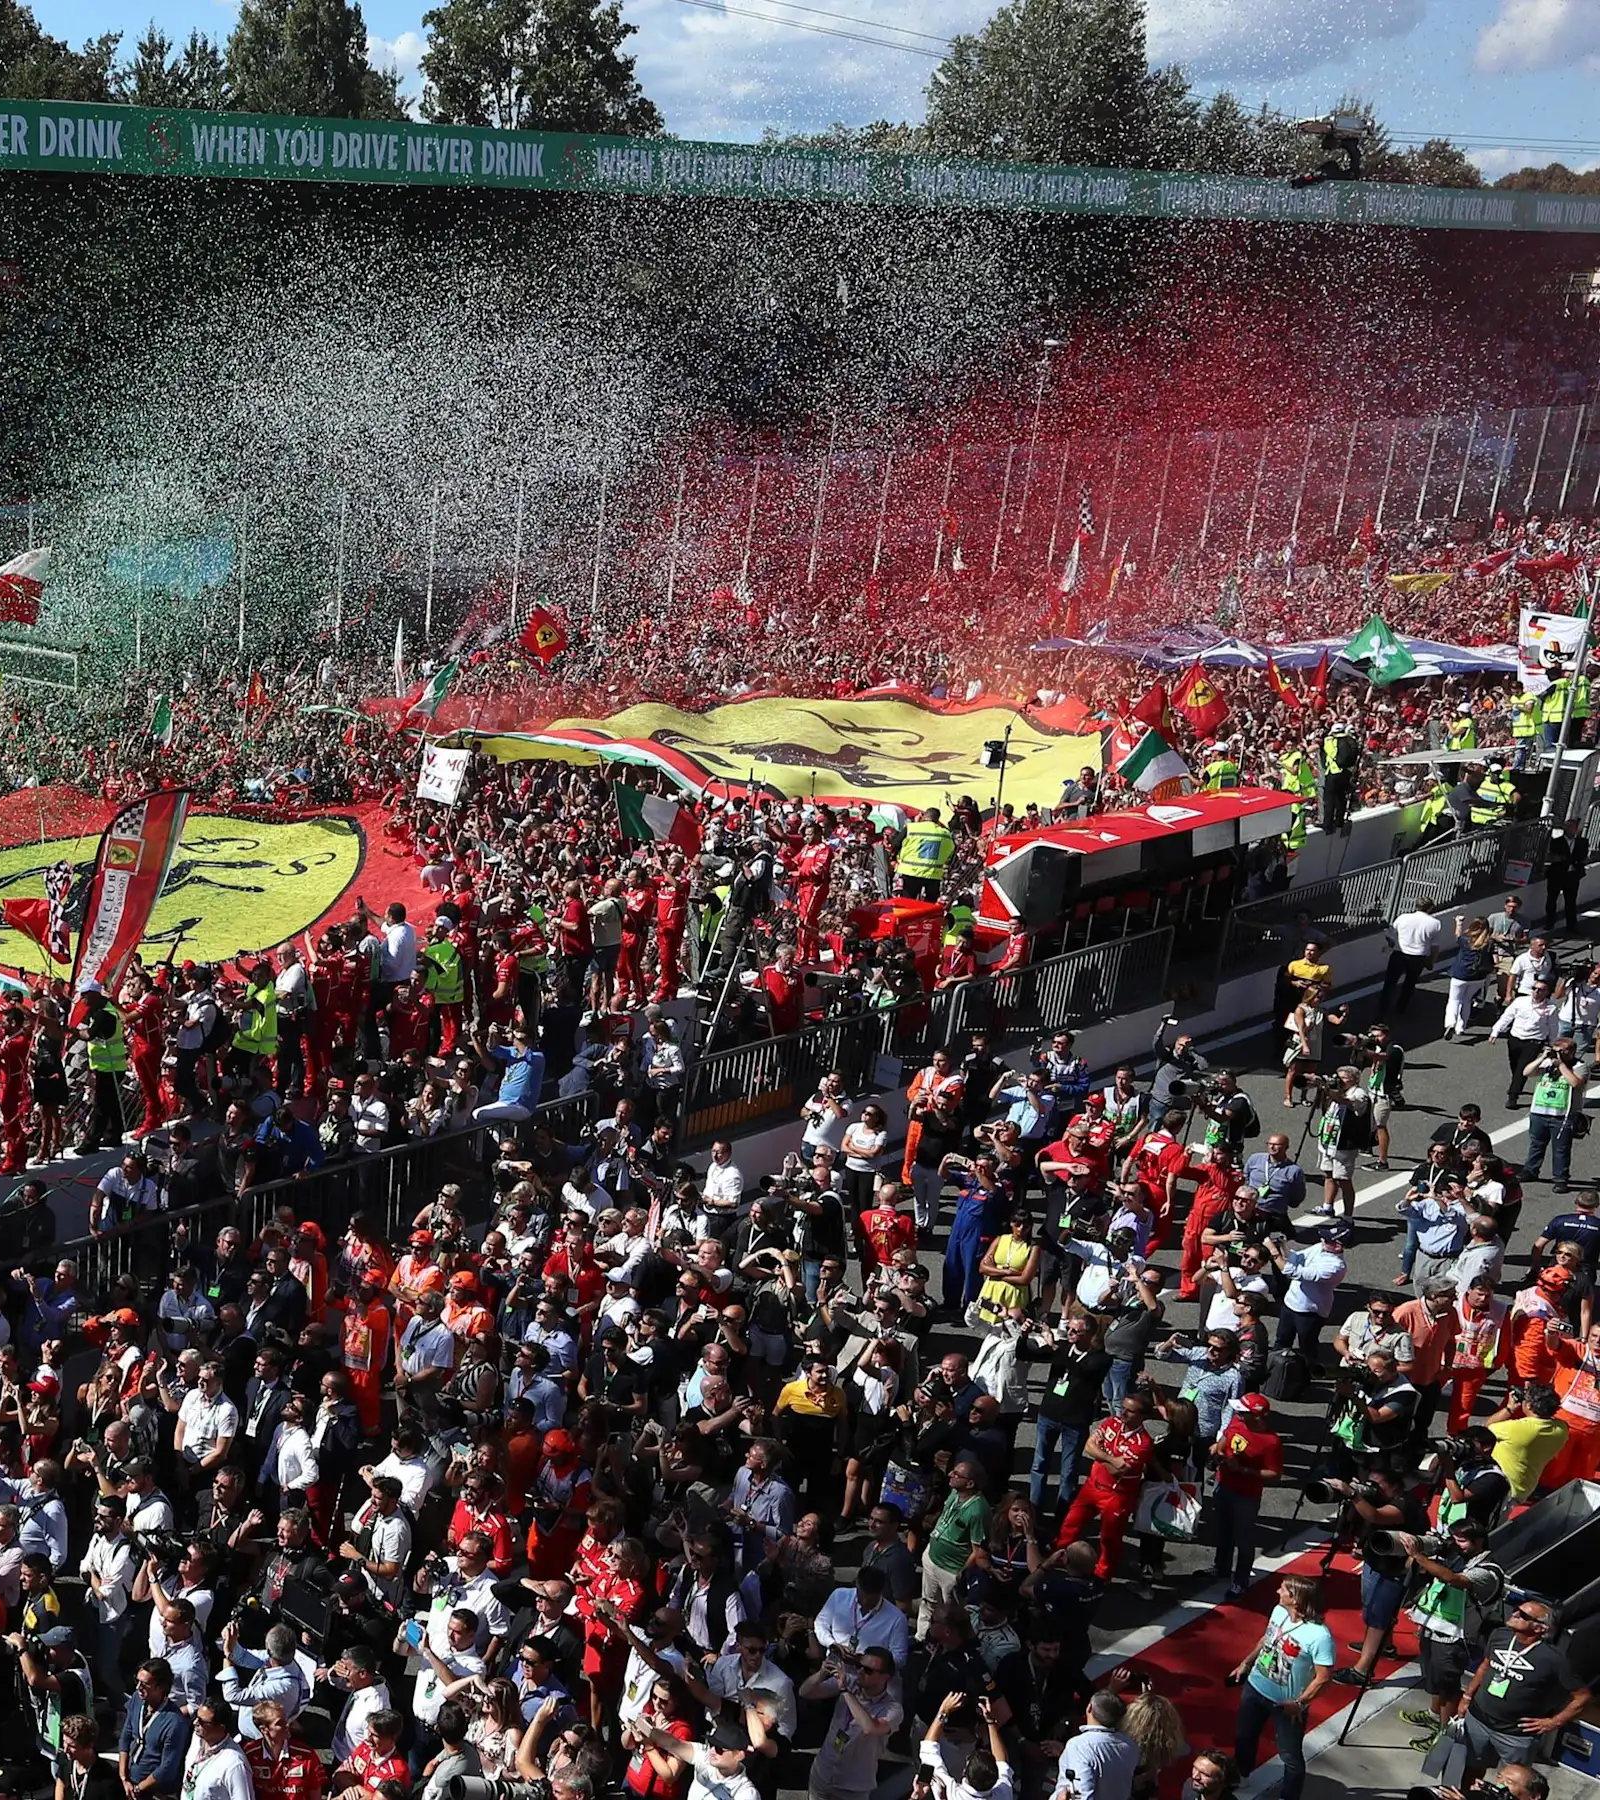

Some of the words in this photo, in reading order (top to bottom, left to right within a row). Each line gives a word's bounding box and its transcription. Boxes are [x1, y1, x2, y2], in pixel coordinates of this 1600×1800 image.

[39, 116, 123, 159] DRINK
[192, 122, 266, 165] WHEN
[274, 127, 325, 168] YOU
[333, 131, 399, 171] DRIVE
[406, 136, 473, 175] NEVER
[481, 140, 545, 178] DRINK
[1536, 200, 1563, 223] WHEN
[1565, 201, 1584, 224] YOU
[82, 918, 109, 970] FERRARI
[104, 874, 118, 912] CLUB
[102, 915, 119, 946] Ferrari
[113, 876, 127, 913] Passion
